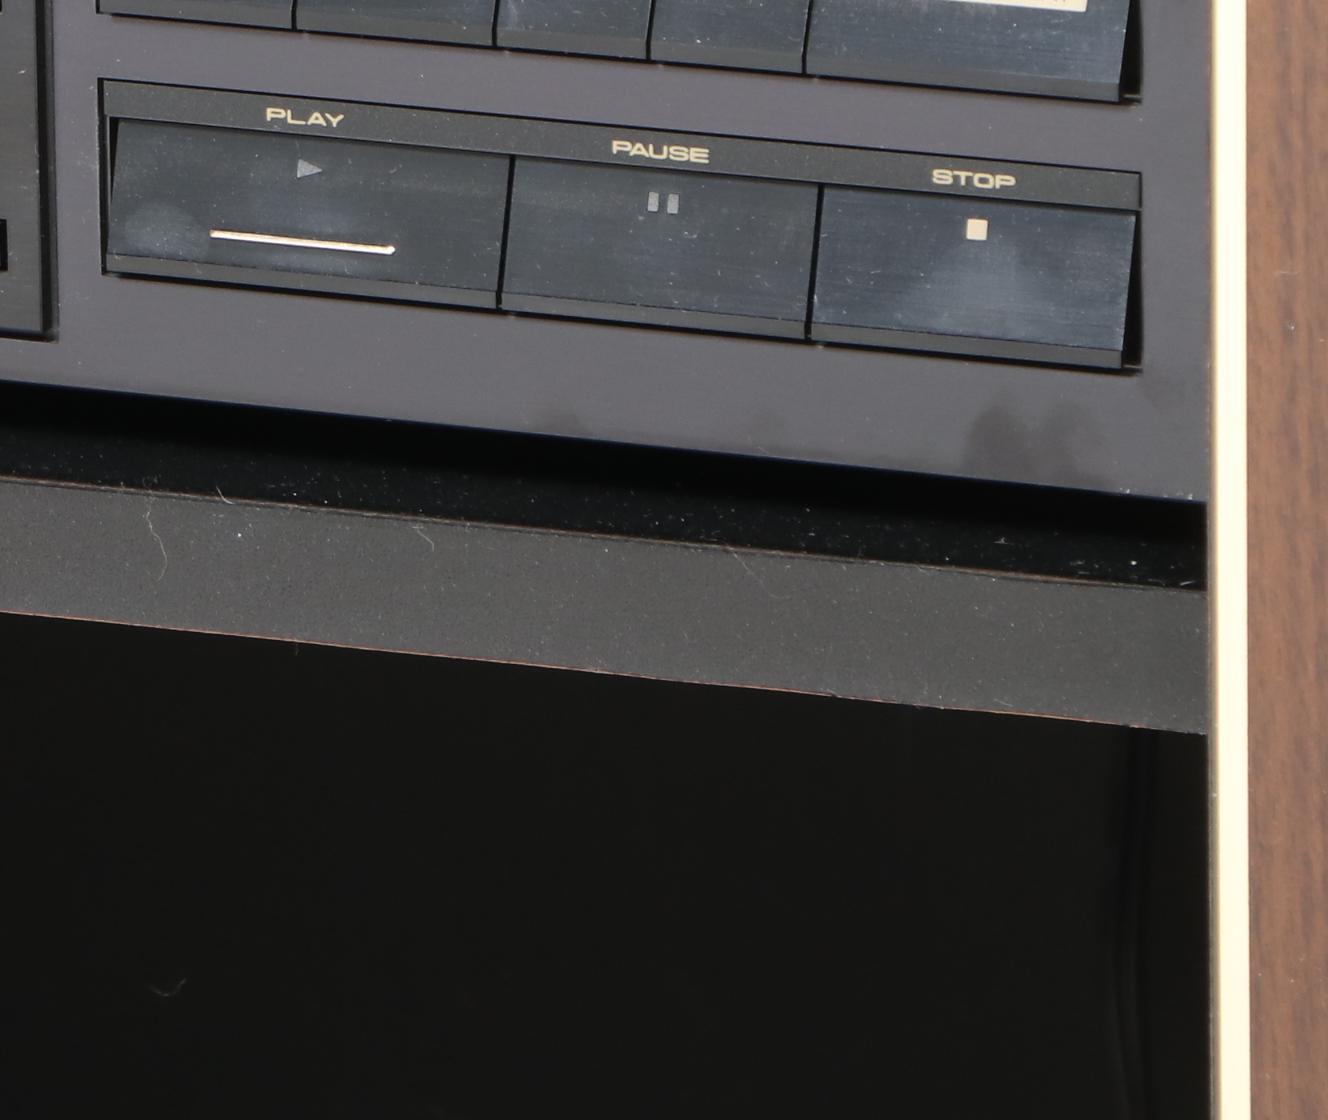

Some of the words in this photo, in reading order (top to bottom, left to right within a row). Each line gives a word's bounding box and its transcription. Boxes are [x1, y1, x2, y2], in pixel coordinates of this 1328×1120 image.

[266, 107, 345, 128] PLAY
[612, 140, 710, 164] PAUSE
[932, 168, 1016, 189] STOP
